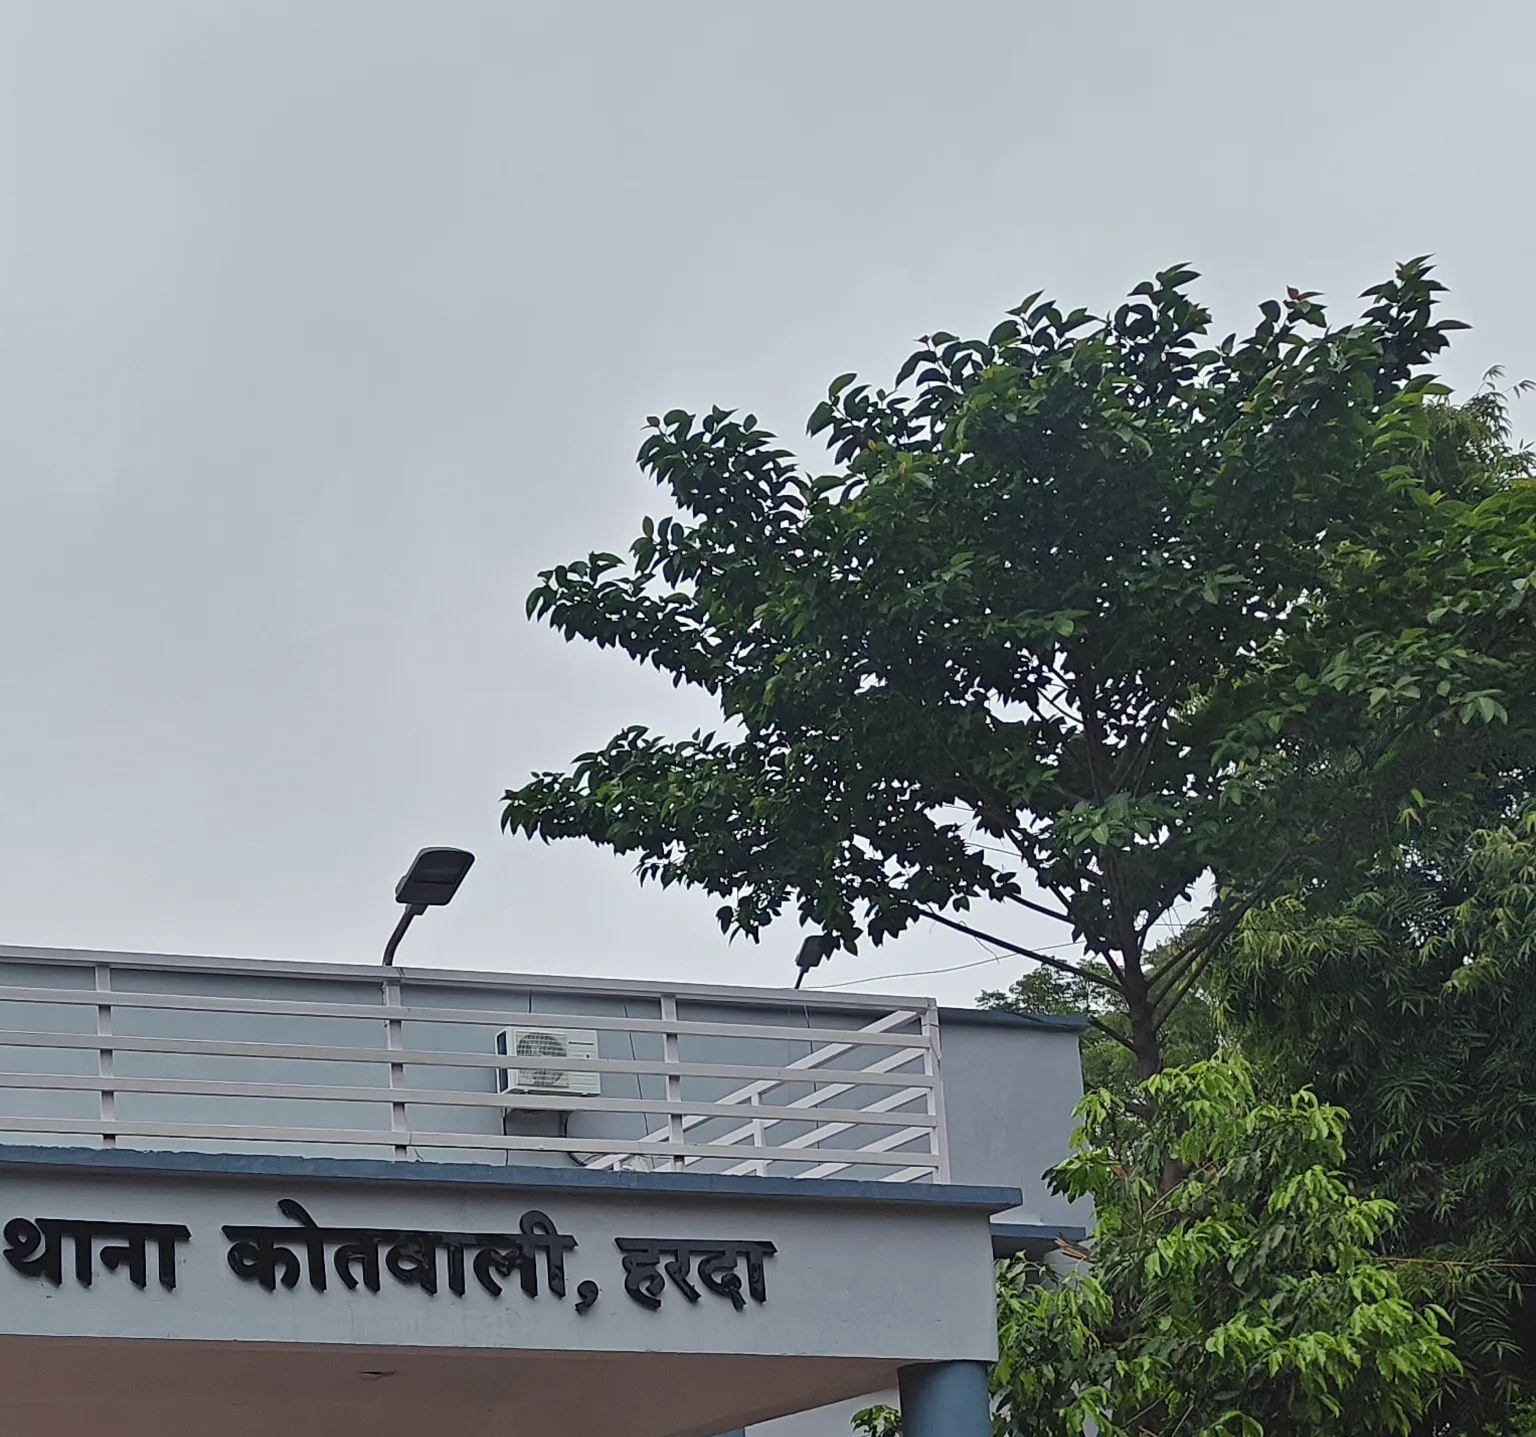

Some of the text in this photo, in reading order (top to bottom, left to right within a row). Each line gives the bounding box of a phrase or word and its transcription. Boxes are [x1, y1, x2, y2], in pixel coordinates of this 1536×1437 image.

[2, 1199, 778, 1317] थाना कोतवाली, हरदा
